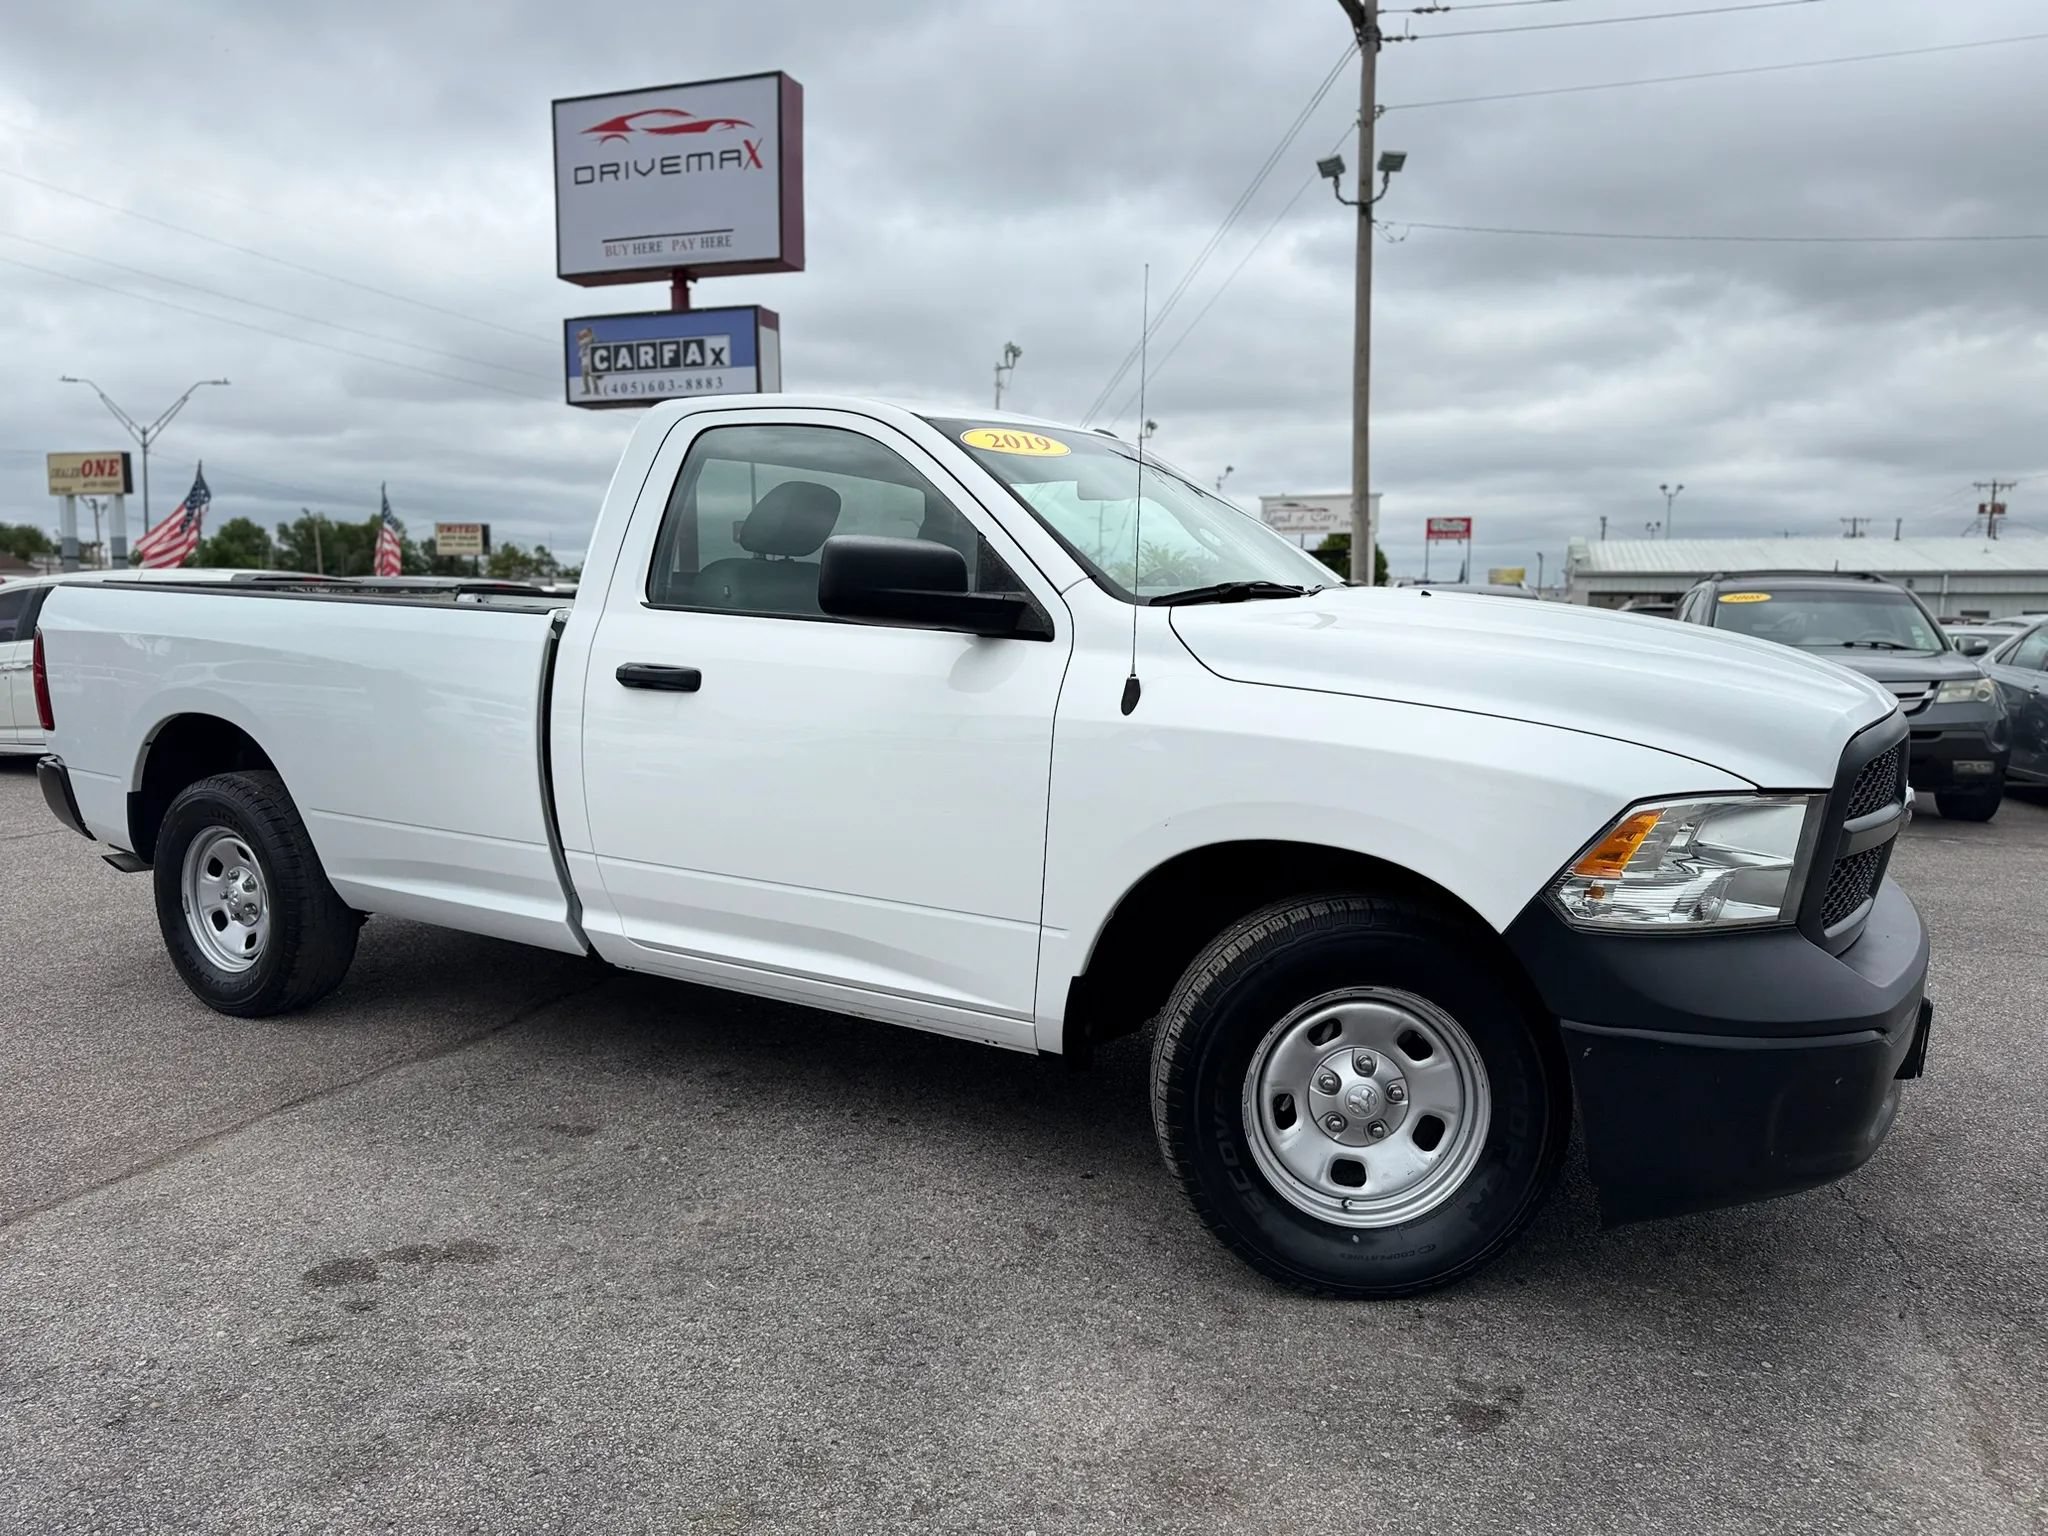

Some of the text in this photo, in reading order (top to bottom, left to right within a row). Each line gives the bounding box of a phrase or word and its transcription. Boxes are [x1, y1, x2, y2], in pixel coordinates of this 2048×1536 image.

[574, 137, 763, 185] DRIVEMAX
[605, 235, 732, 257] BUY HERE PAY HERE
[593, 340, 726, 370] CARFAX
[603, 377, 723, 396] (405)603-8883
[985, 433, 1051, 450] 2019
[82, 458, 119, 478] ONE
